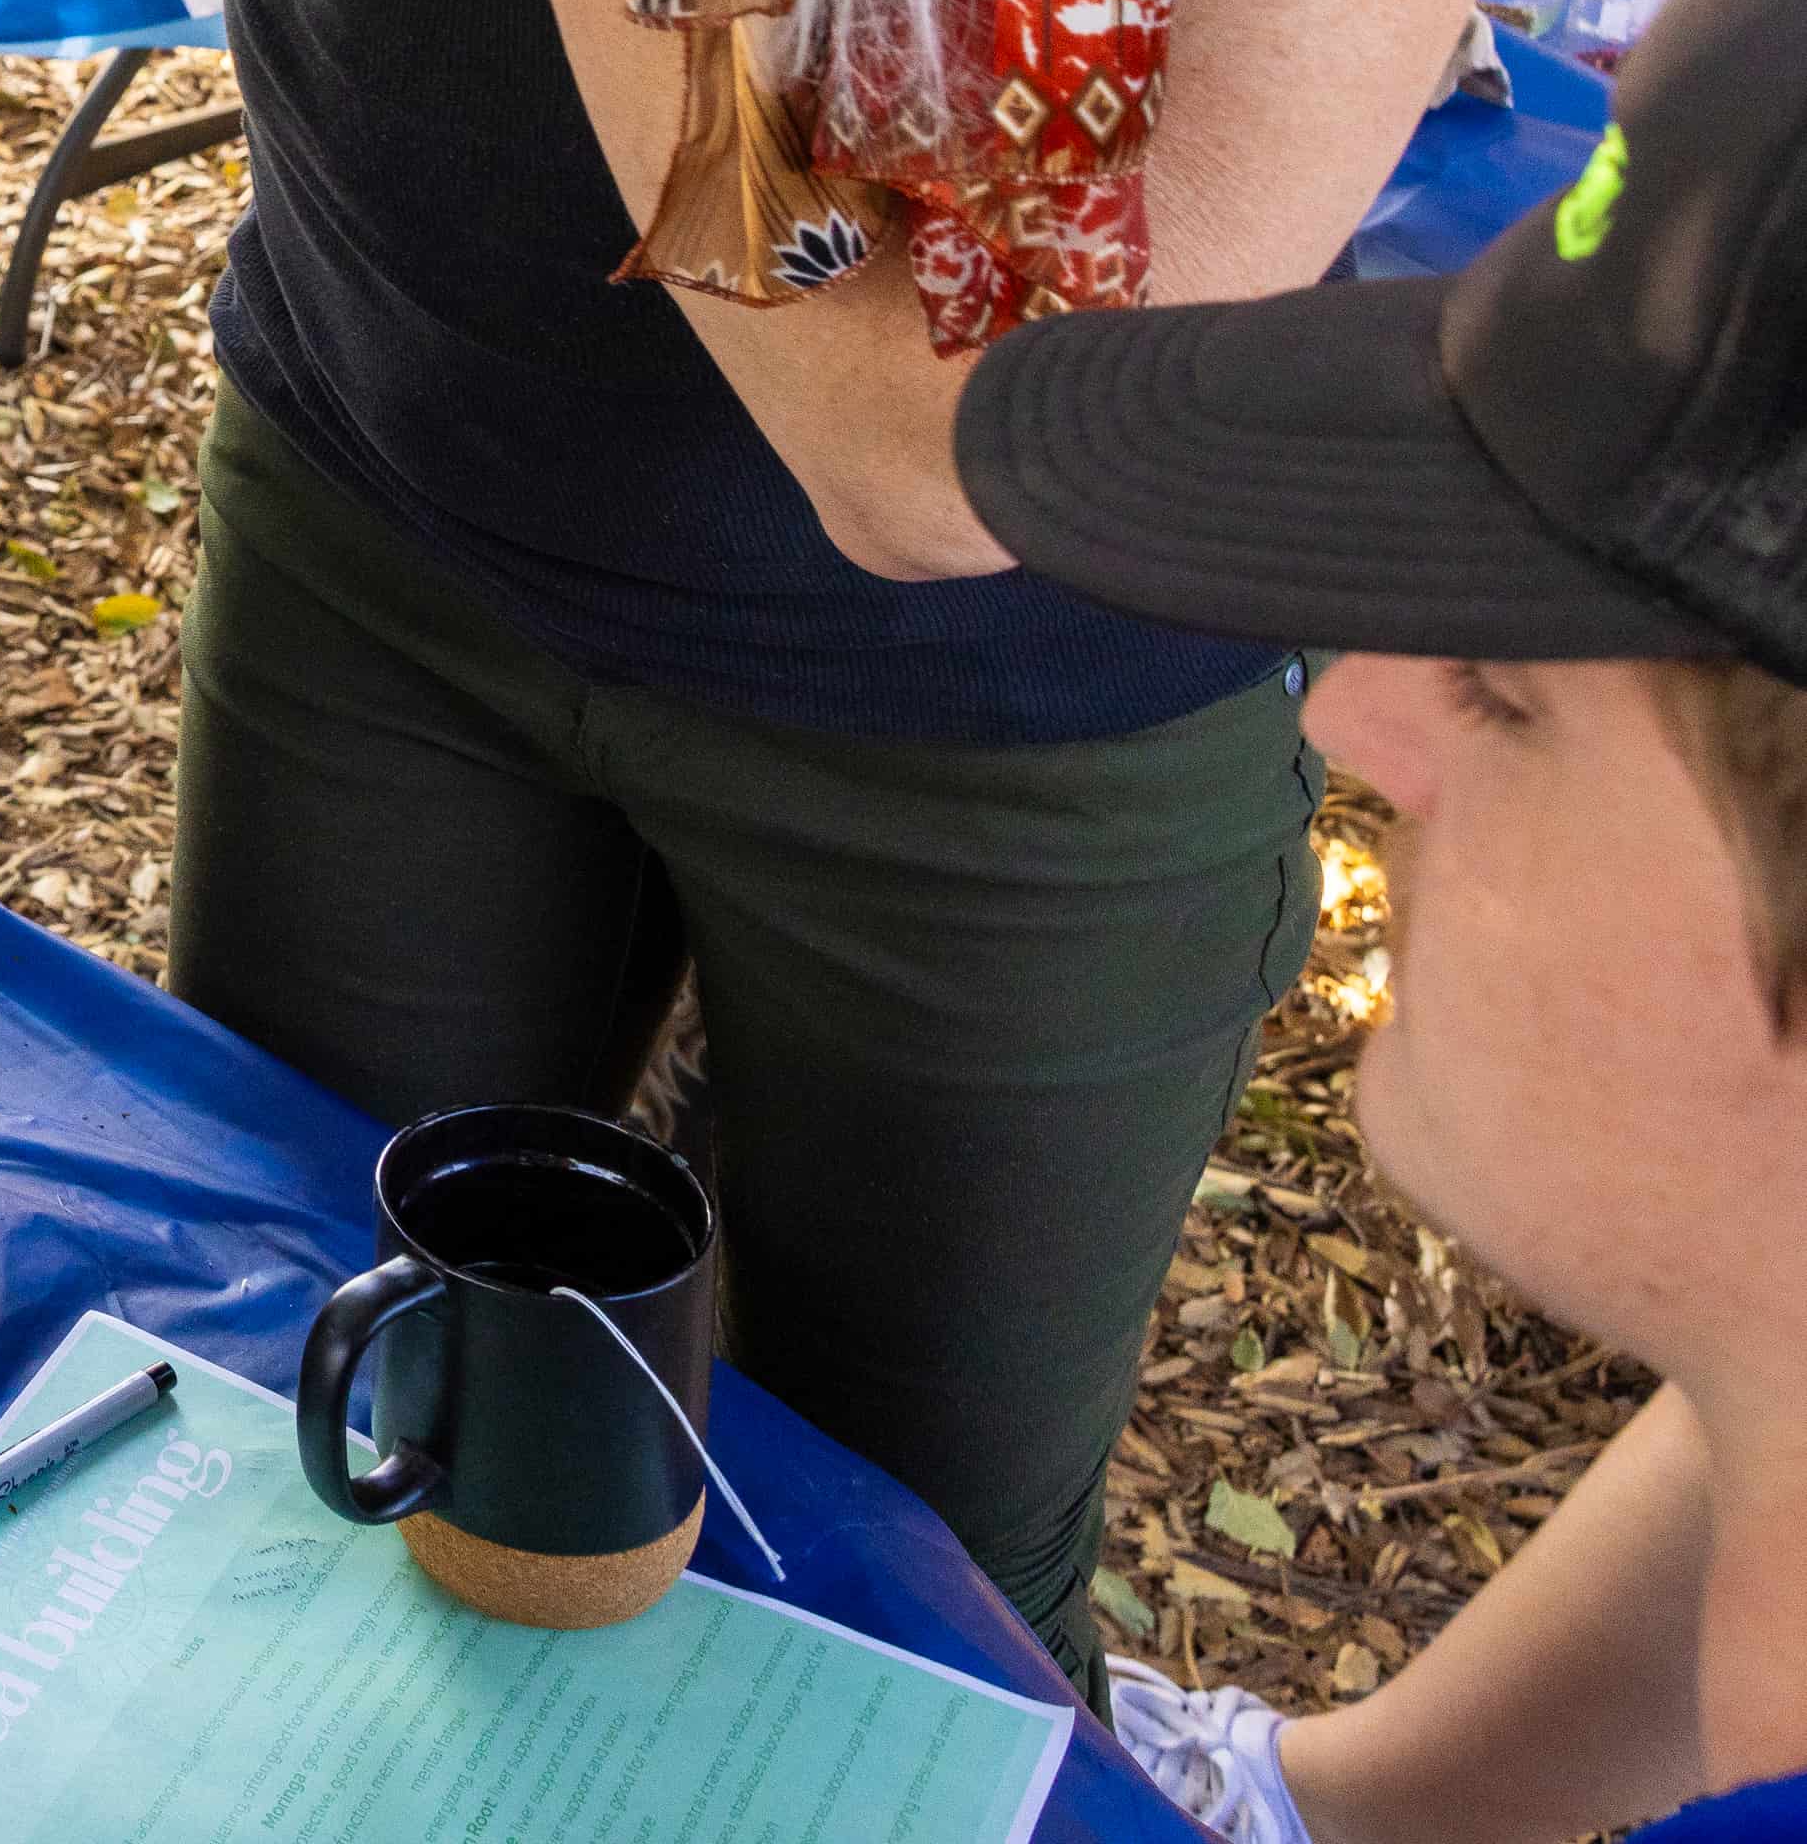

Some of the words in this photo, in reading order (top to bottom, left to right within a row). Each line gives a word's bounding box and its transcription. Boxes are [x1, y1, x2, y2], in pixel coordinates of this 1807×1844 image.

[172, 1633, 204, 1672] Herbs
[264, 1656, 304, 1705] function
[241, 1762, 270, 1797] often
[264, 1730, 294, 1765] good
[286, 1711, 304, 1730] for
[263, 1770, 309, 1831] Moringa
[300, 1736, 329, 1771] good
[322, 1714, 342, 1736] for
[330, 1754, 358, 1790] good
[352, 1733, 370, 1754] for
[410, 1746, 443, 1791] mental
[435, 1705, 470, 1749] fatigue
[467, 1796, 497, 1835] Root
[490, 1770, 512, 1797] liver
[511, 1799, 539, 1833] liver
[529, 1753, 566, 1803] support
[558, 1771, 597, 1823] support
